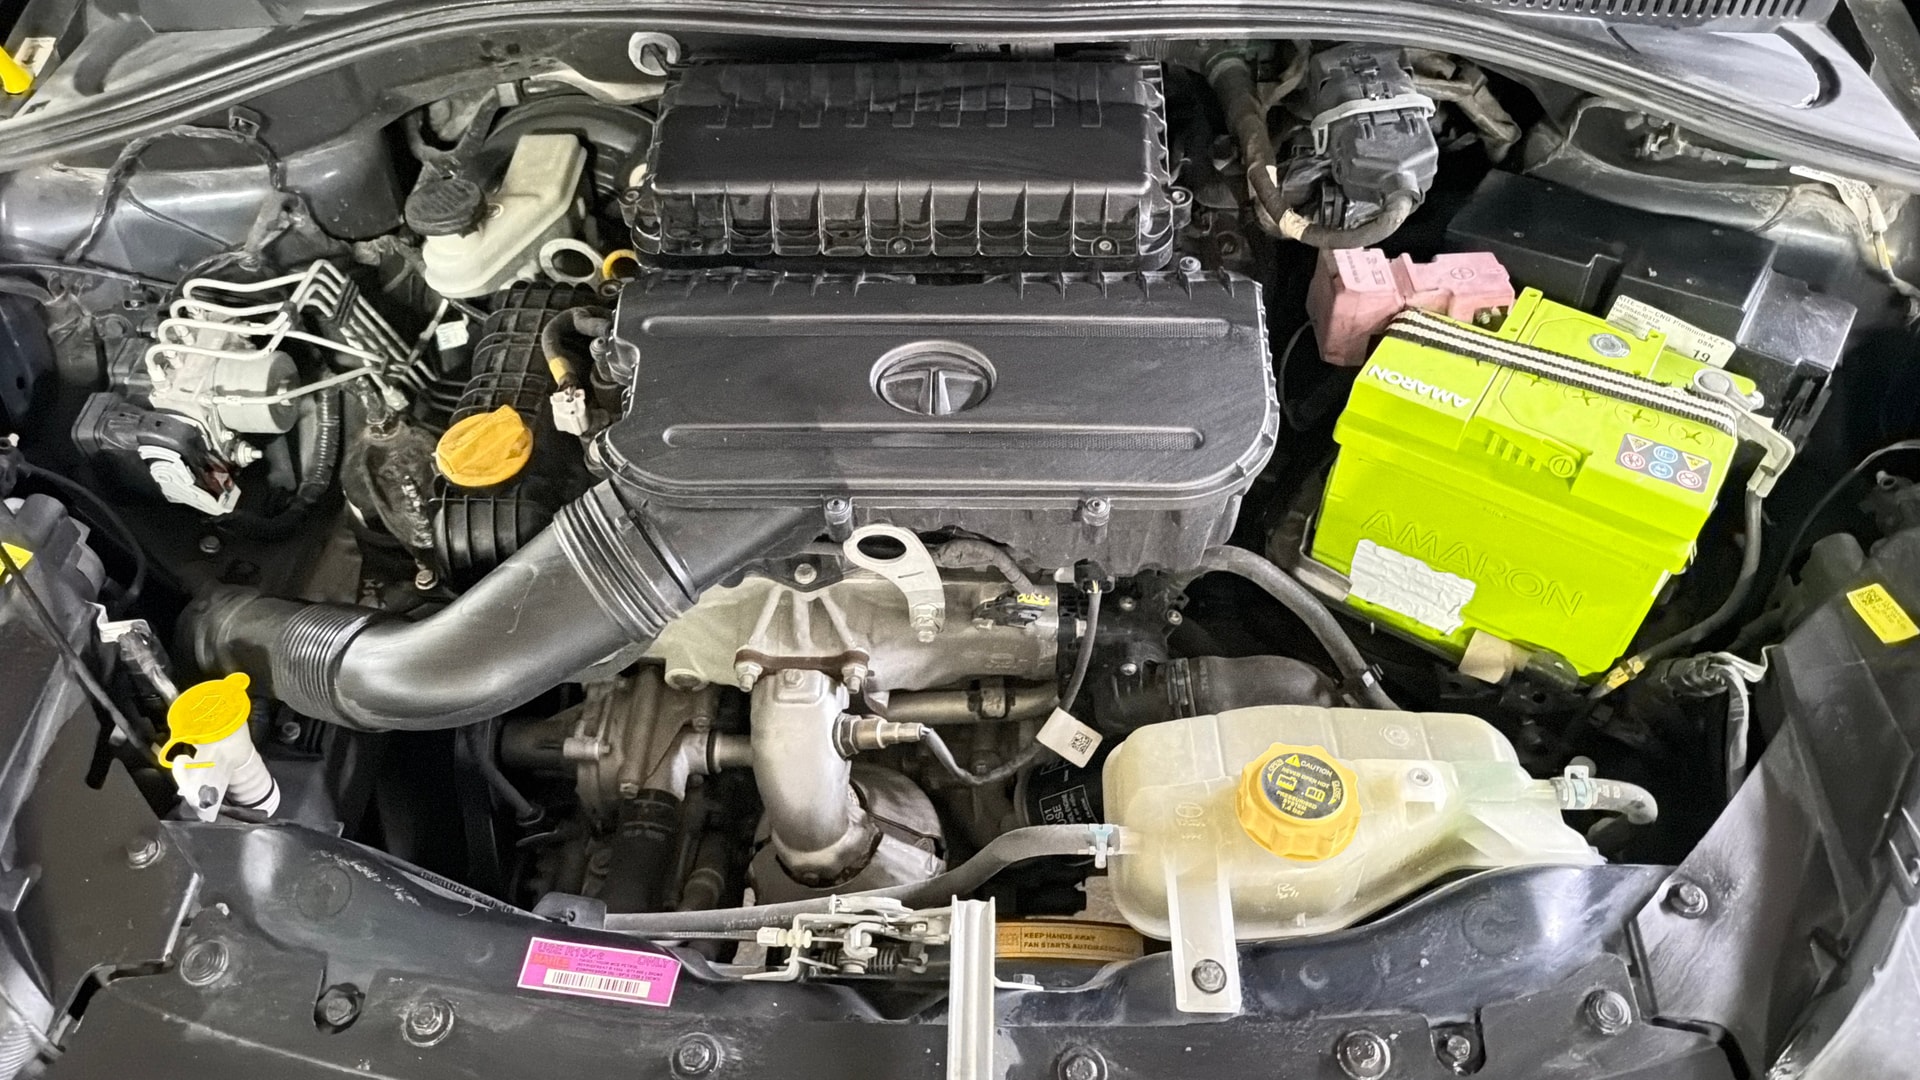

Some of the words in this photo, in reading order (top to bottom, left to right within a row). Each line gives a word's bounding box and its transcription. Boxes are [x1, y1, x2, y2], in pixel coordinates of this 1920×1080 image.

[1692, 348, 1711, 363] 19
[1367, 364, 1471, 409] AMARON
[1360, 510, 1584, 617] AMARON
[1281, 767, 1301, 778] NEVER
[1301, 760, 1333, 777] CAUTION
